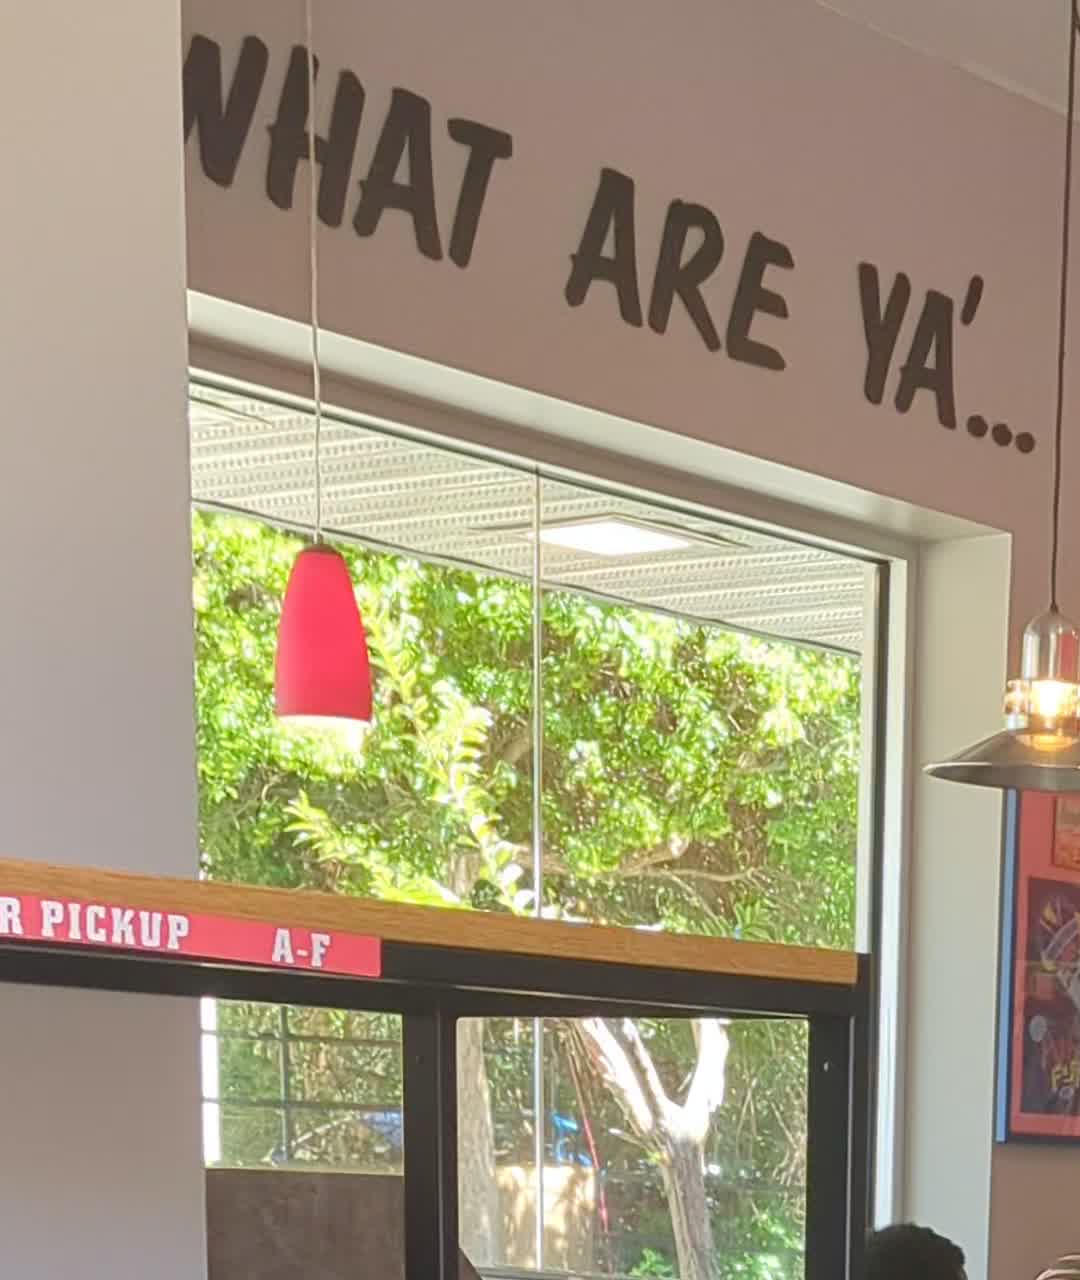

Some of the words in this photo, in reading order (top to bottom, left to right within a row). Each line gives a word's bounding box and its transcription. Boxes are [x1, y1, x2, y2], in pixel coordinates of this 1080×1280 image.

[183, 35, 512, 268] WHAT
[564, 168, 795, 371] ARE
[40, 899, 191, 950] PICKUP
[271, 927, 331, 968] A-F
